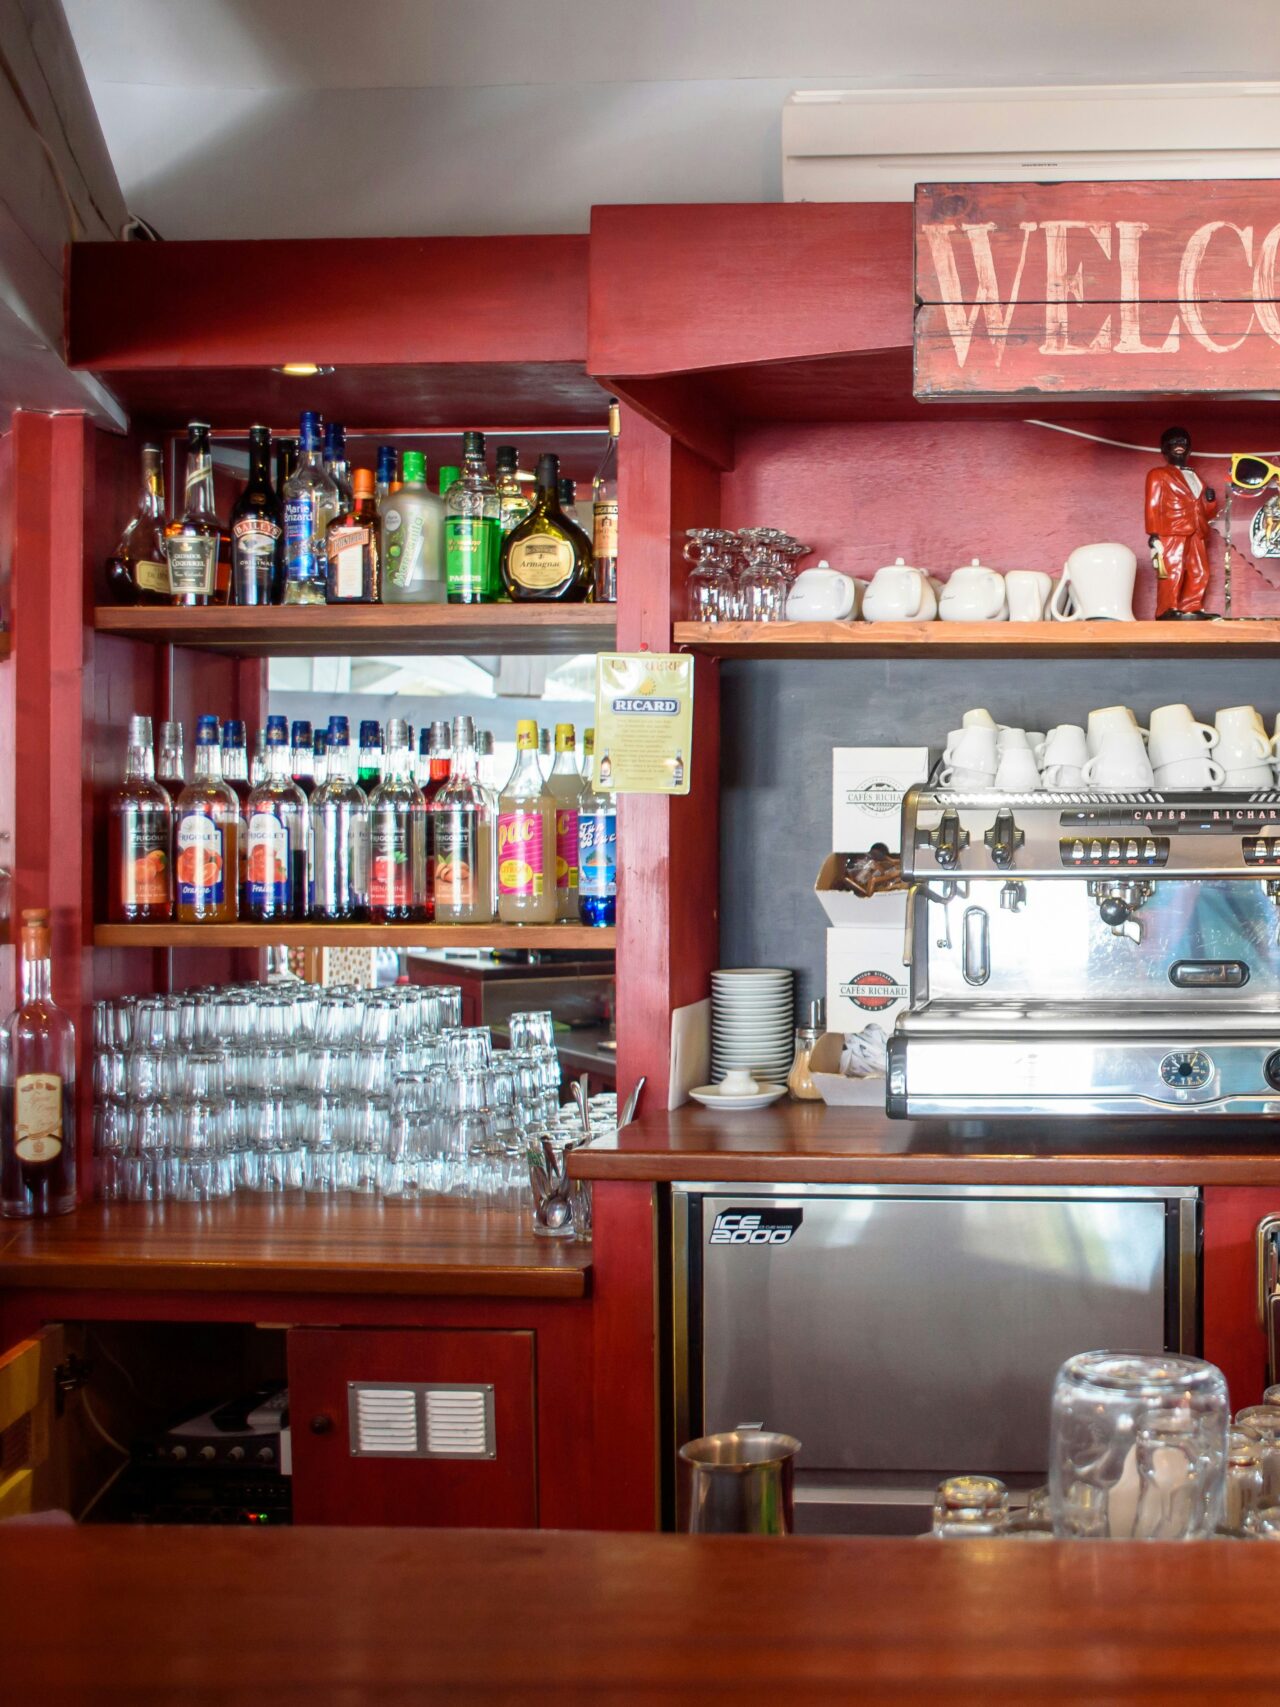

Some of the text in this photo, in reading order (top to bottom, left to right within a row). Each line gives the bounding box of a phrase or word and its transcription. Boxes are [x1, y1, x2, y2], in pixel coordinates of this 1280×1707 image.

[286, 504, 311, 513] Marie
[235, 521, 279, 537] BAILEYS
[615, 700, 676, 712] RICARD
[1134, 810, 1187, 820] CAFÉS
[183, 885, 211, 895] Orange
[840, 986, 908, 996] CAFÉS RICHARD
[714, 1215, 761, 1230] ICE
[710, 1230, 791, 1244] 2000
